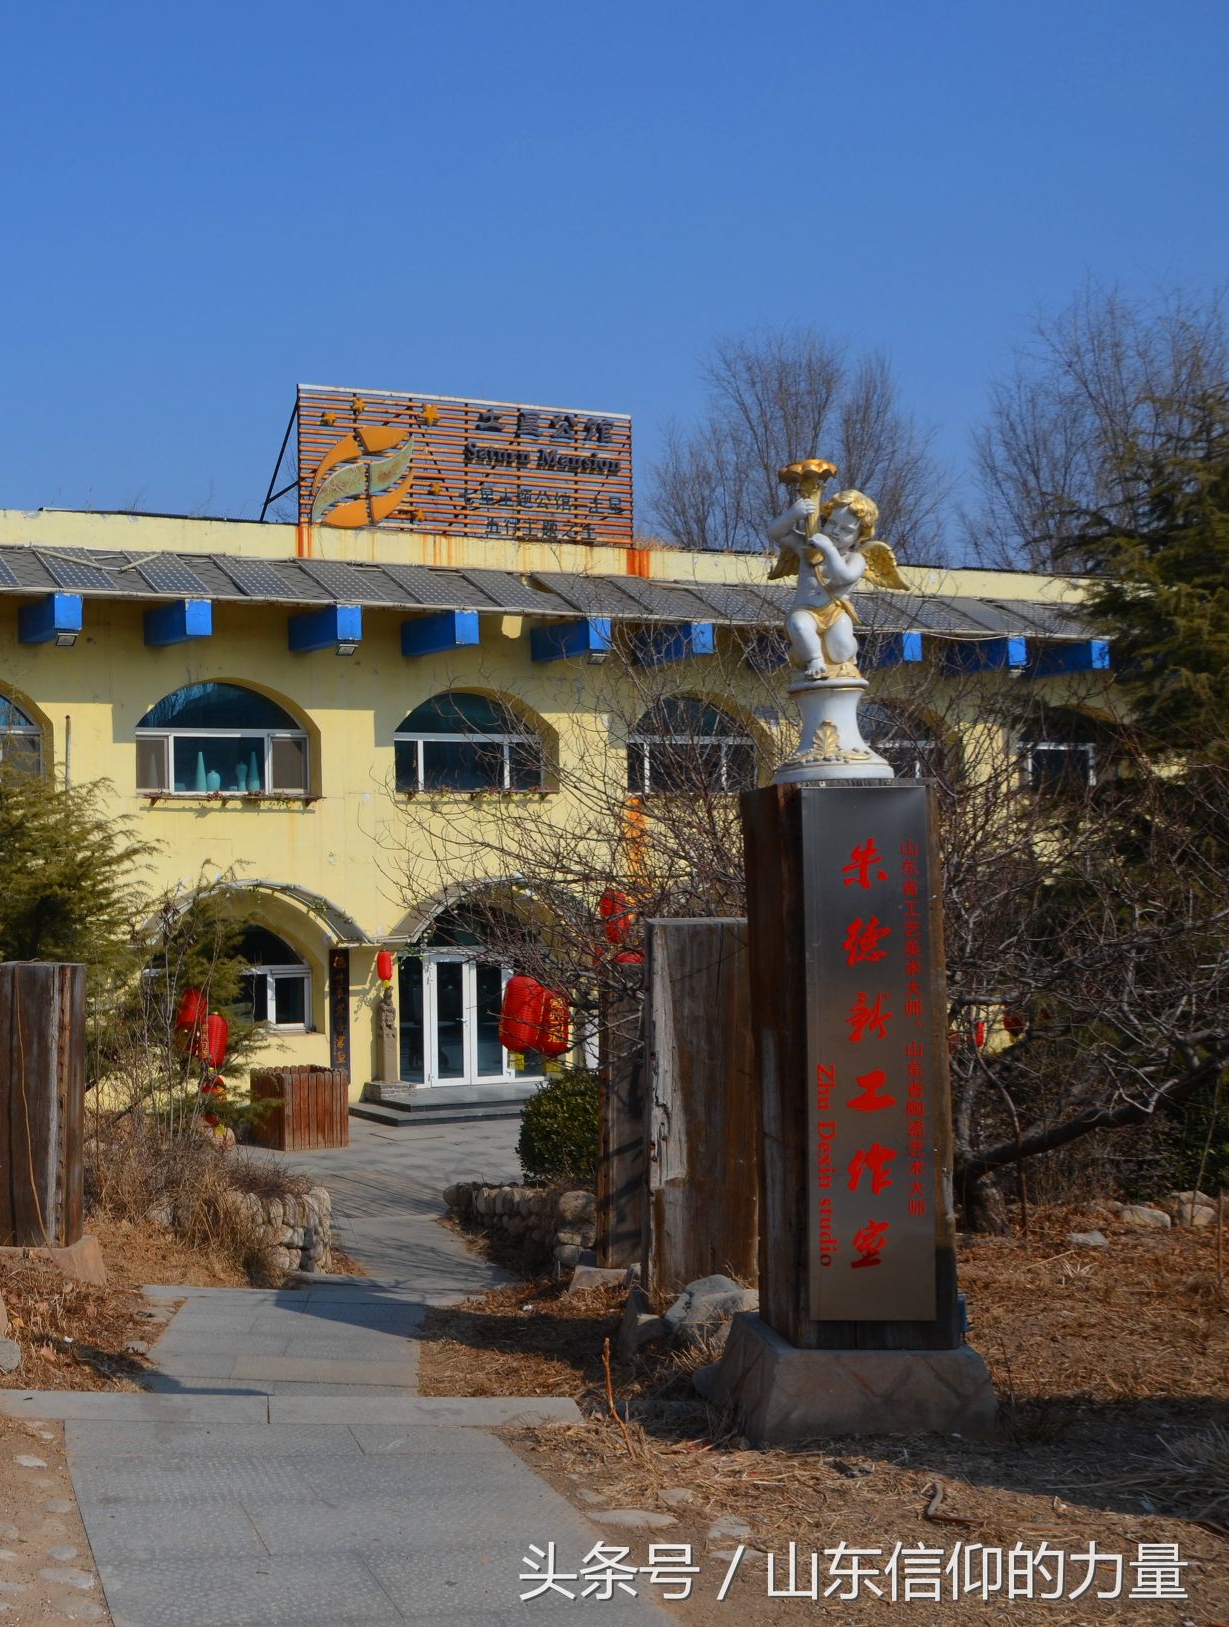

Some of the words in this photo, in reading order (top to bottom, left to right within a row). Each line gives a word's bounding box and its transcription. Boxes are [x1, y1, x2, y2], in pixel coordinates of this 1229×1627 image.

[537, 448, 622, 474] Mansion
[817, 1063, 836, 1110] Zhu
[841, 837, 897, 1268] 朱德新工作室
[818, 1121, 837, 1189] Dexin
[819, 1198, 839, 1268] studio
